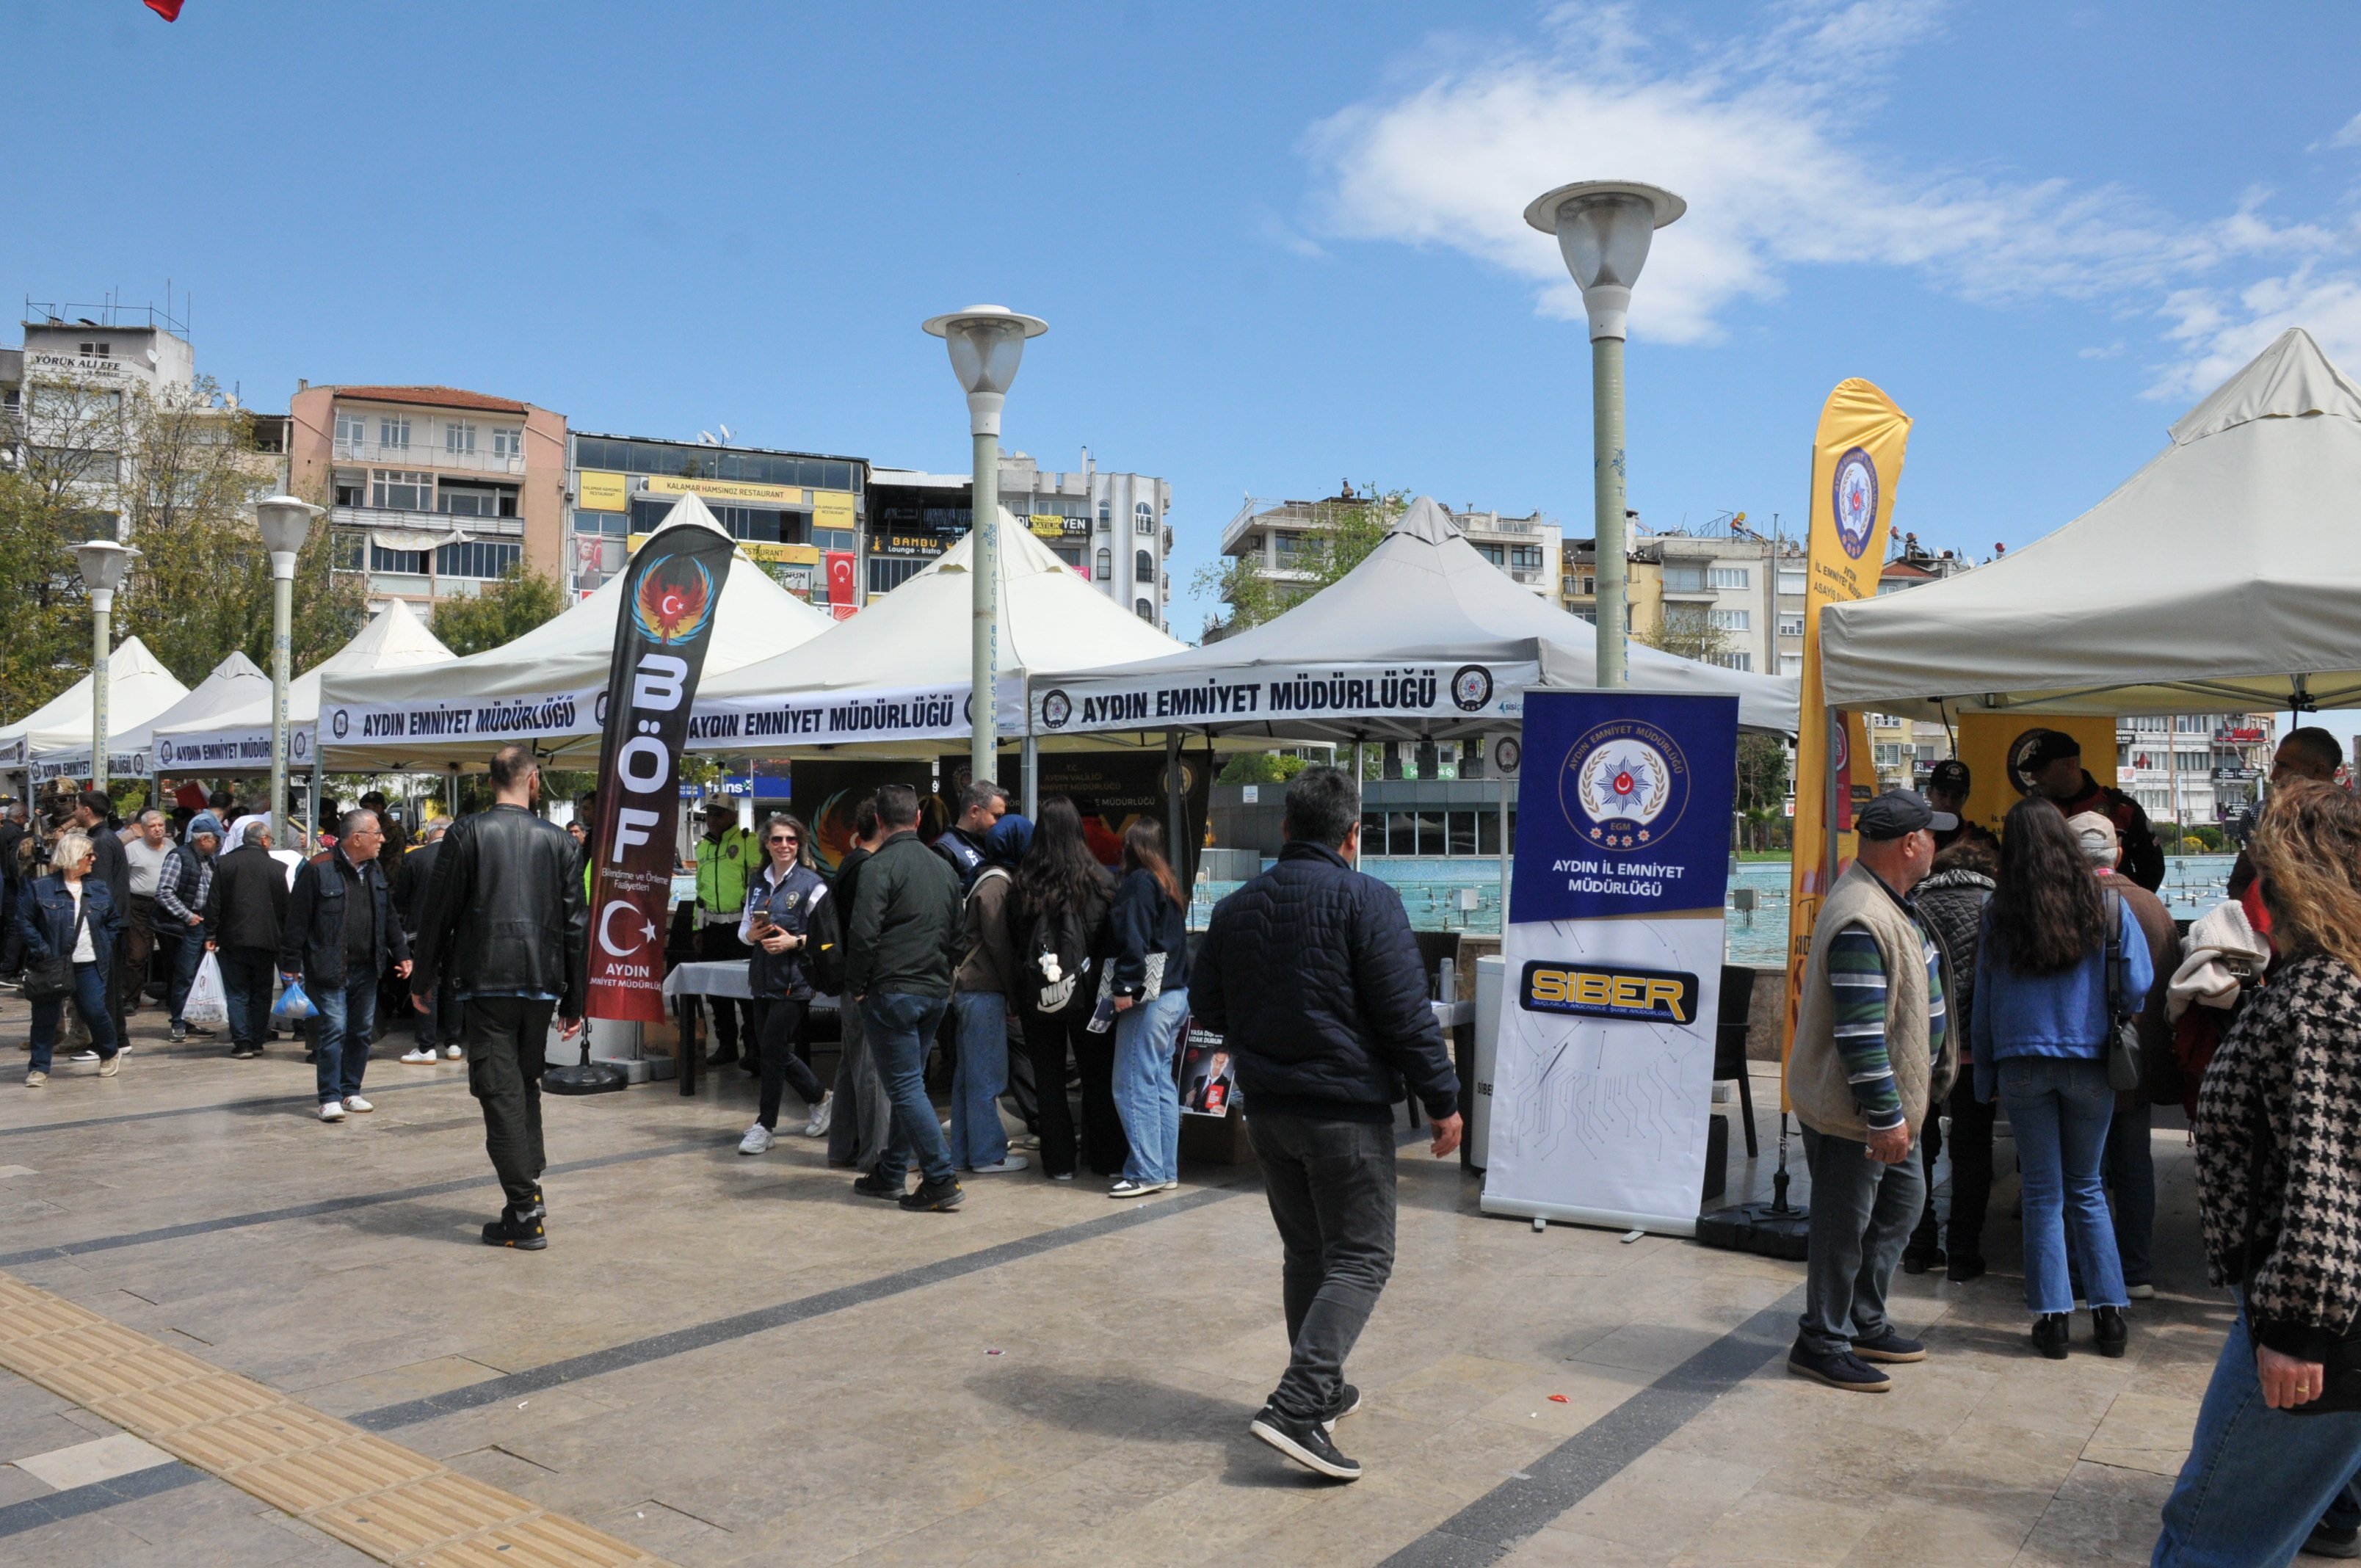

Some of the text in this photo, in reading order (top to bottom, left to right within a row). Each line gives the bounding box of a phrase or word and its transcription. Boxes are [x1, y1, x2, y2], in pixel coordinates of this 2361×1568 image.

[35, 354, 121, 370] YÖRÜK ALİ EFE
[667, 482, 700, 492] KALAMAR
[739, 488, 785, 498] RESTAURANT
[888, 546, 915, 555] Lounge
[893, 537, 937, 548] BAMBU
[1081, 668, 1437, 724] AYDIN EMNİYET MÜDÜRLÜĞÜ
[363, 694, 576, 736] AYDIN EMNİYET MÜDÜRLÜĞÜ
[689, 694, 954, 739] AYDIN EMNİYET MÜDÜRLÜĞÜ
[177, 746, 201, 762] AYDIN
[203, 738, 237, 761] EMNİYET
[1568, 725, 1685, 774] AYDIN EMNİYET MÜDÜRLÜĞÜ
[43, 761, 62, 779] AYDIN
[63, 757, 90, 777] EMNİYET
[1102, 796, 1156, 807] MÜDÜRLÜĞÜ
[1610, 822, 1631, 831] EGM
[636, 873, 645, 881] ve
[1552, 859, 1685, 879] AYDIN İL EMNİYET
[1568, 877, 1662, 897] MÜDÜRLÜĞÜ
[606, 962, 650, 978] AYDIN
[1040, 973, 1076, 1006] NIKE
[1534, 999, 1567, 1009] SUÇLARLA
[1570, 1003, 1607, 1012] MÜCADELE
[1477, 1080, 1494, 1097] SİBE
